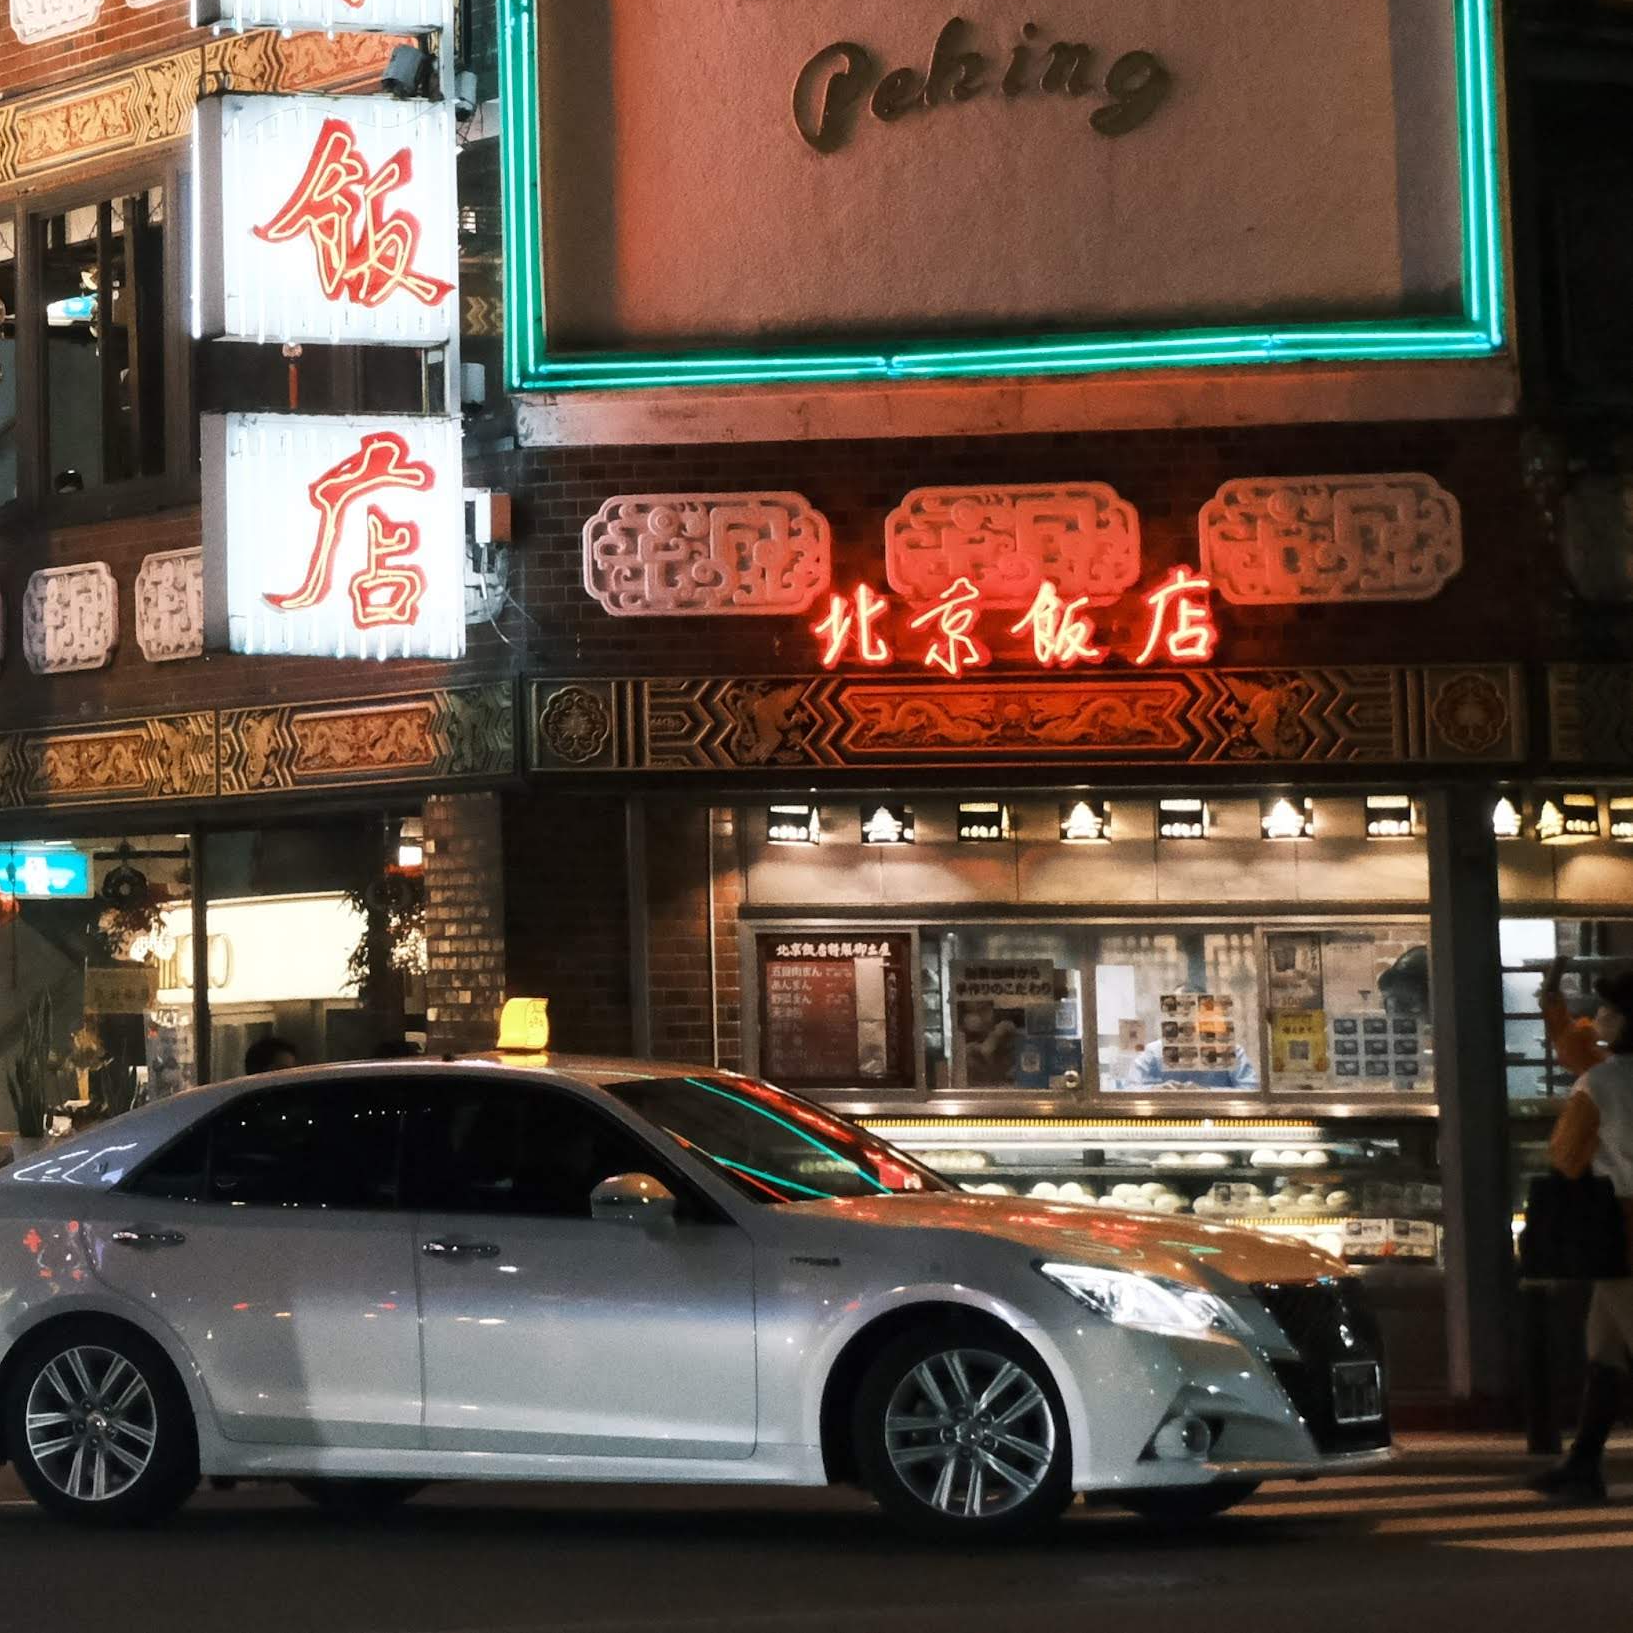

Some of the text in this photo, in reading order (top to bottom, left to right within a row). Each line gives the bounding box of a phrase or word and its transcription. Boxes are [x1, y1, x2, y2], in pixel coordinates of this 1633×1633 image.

[791, 15, 1173, 154] Peking
[810, 567, 1219, 677] 北京飯店
